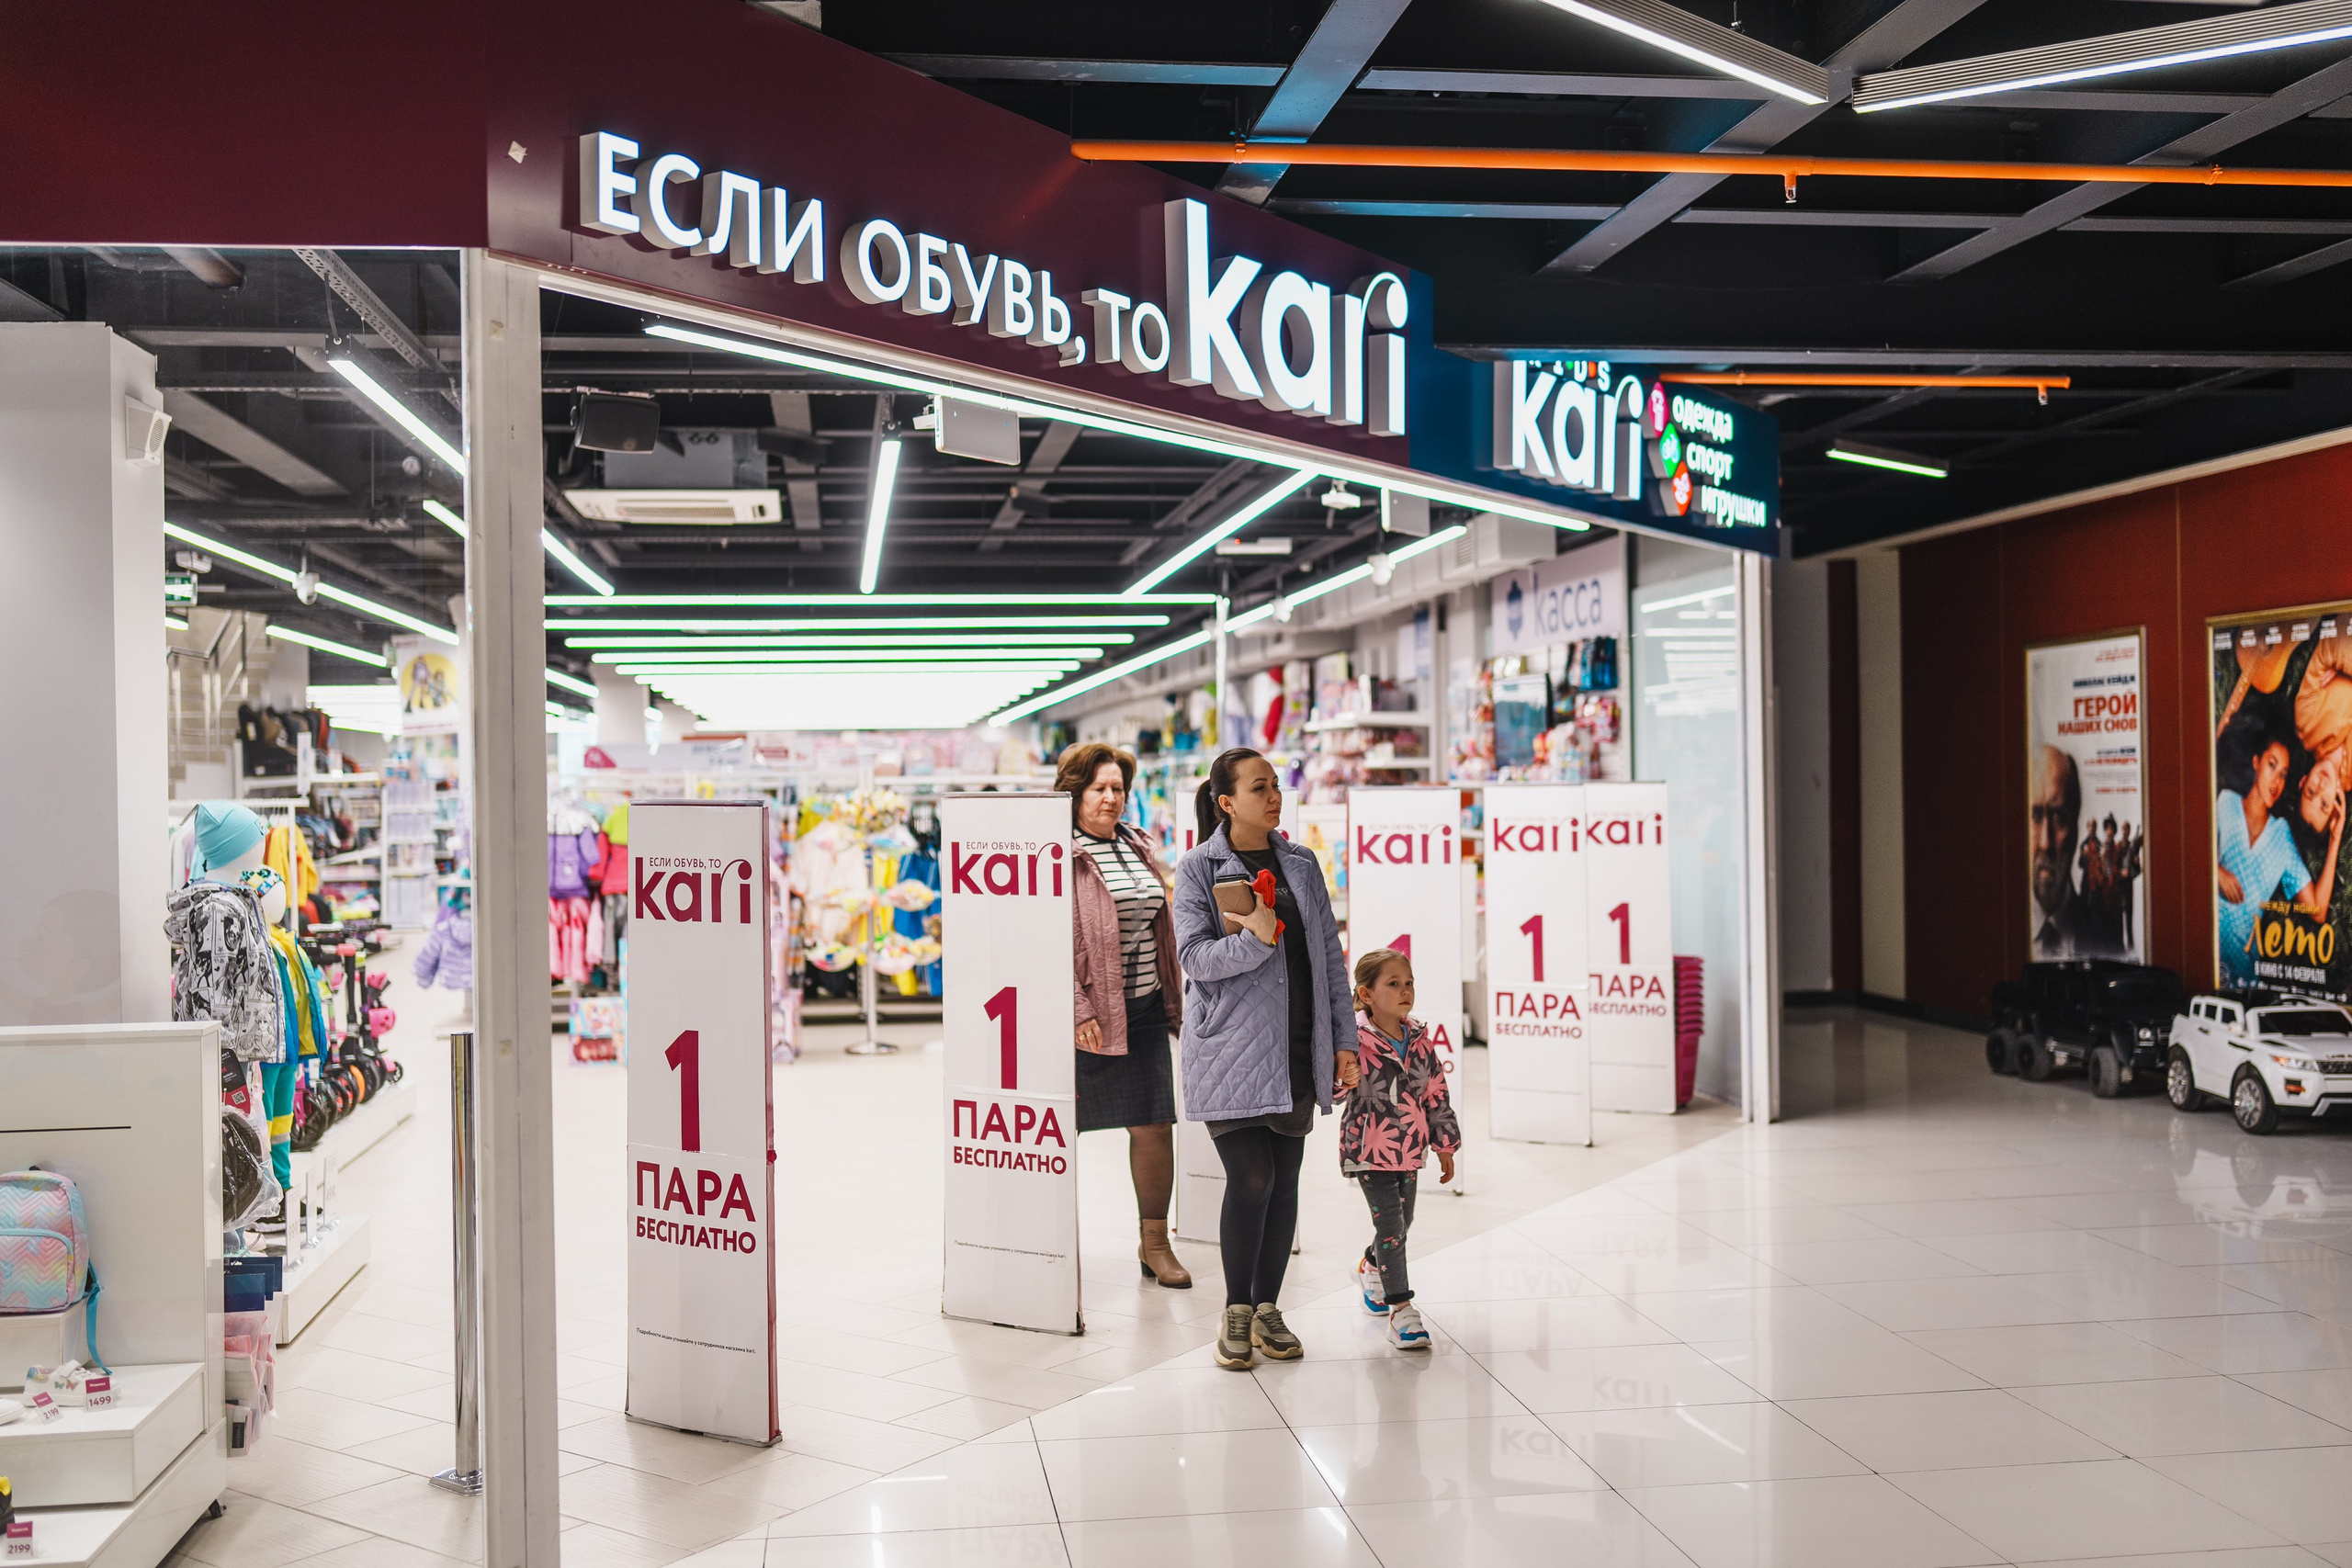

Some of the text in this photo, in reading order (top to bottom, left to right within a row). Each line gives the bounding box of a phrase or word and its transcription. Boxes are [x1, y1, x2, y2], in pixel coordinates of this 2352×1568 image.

[593, 130, 1170, 374] ЕСЛИ ОБУВЬ, ТО
[1181, 197, 1409, 437] kari
[1509, 360, 1645, 502] kari
[1671, 394, 1734, 445] одежда
[1685, 441, 1735, 487] спорт
[1701, 484, 1768, 528] игрушки
[2073, 689, 2137, 718] ГЕРОЙ
[2057, 716, 2138, 734] НАШИХ СНОВ
[966, 841, 1036, 852] ЕСЛИ ОБУВЬ, ТО
[1357, 823, 1452, 864] kari
[1493, 817, 1579, 852] kari
[1586, 812, 1663, 845] kari
[649, 857, 721, 869] ЕСЛИ ОБУВЬ, ТО
[951, 841, 1064, 897] kari
[635, 857, 752, 924] kari
[1520, 914, 1544, 983] 1
[1608, 902, 1631, 964] 1
[1496, 991, 1581, 1021] ПАРА
[1589, 974, 1666, 999] ПАРА
[983, 986, 1018, 1090] 1
[1496, 1022, 1582, 1039] БЕСПЛАТНО
[664, 1029, 701, 1154] 1
[953, 1099, 1067, 1148] ПАРА
[953, 1145, 1067, 1175] БЕСПЛАТНО
[636, 1160, 756, 1223] ПАРА
[636, 1215, 757, 1255] БЕСПЛАТНО
[43, 1407, 59, 1420] 2199
[89, 1395, 111, 1407] 1499
[8, 1543, 31, 1554] 2199
